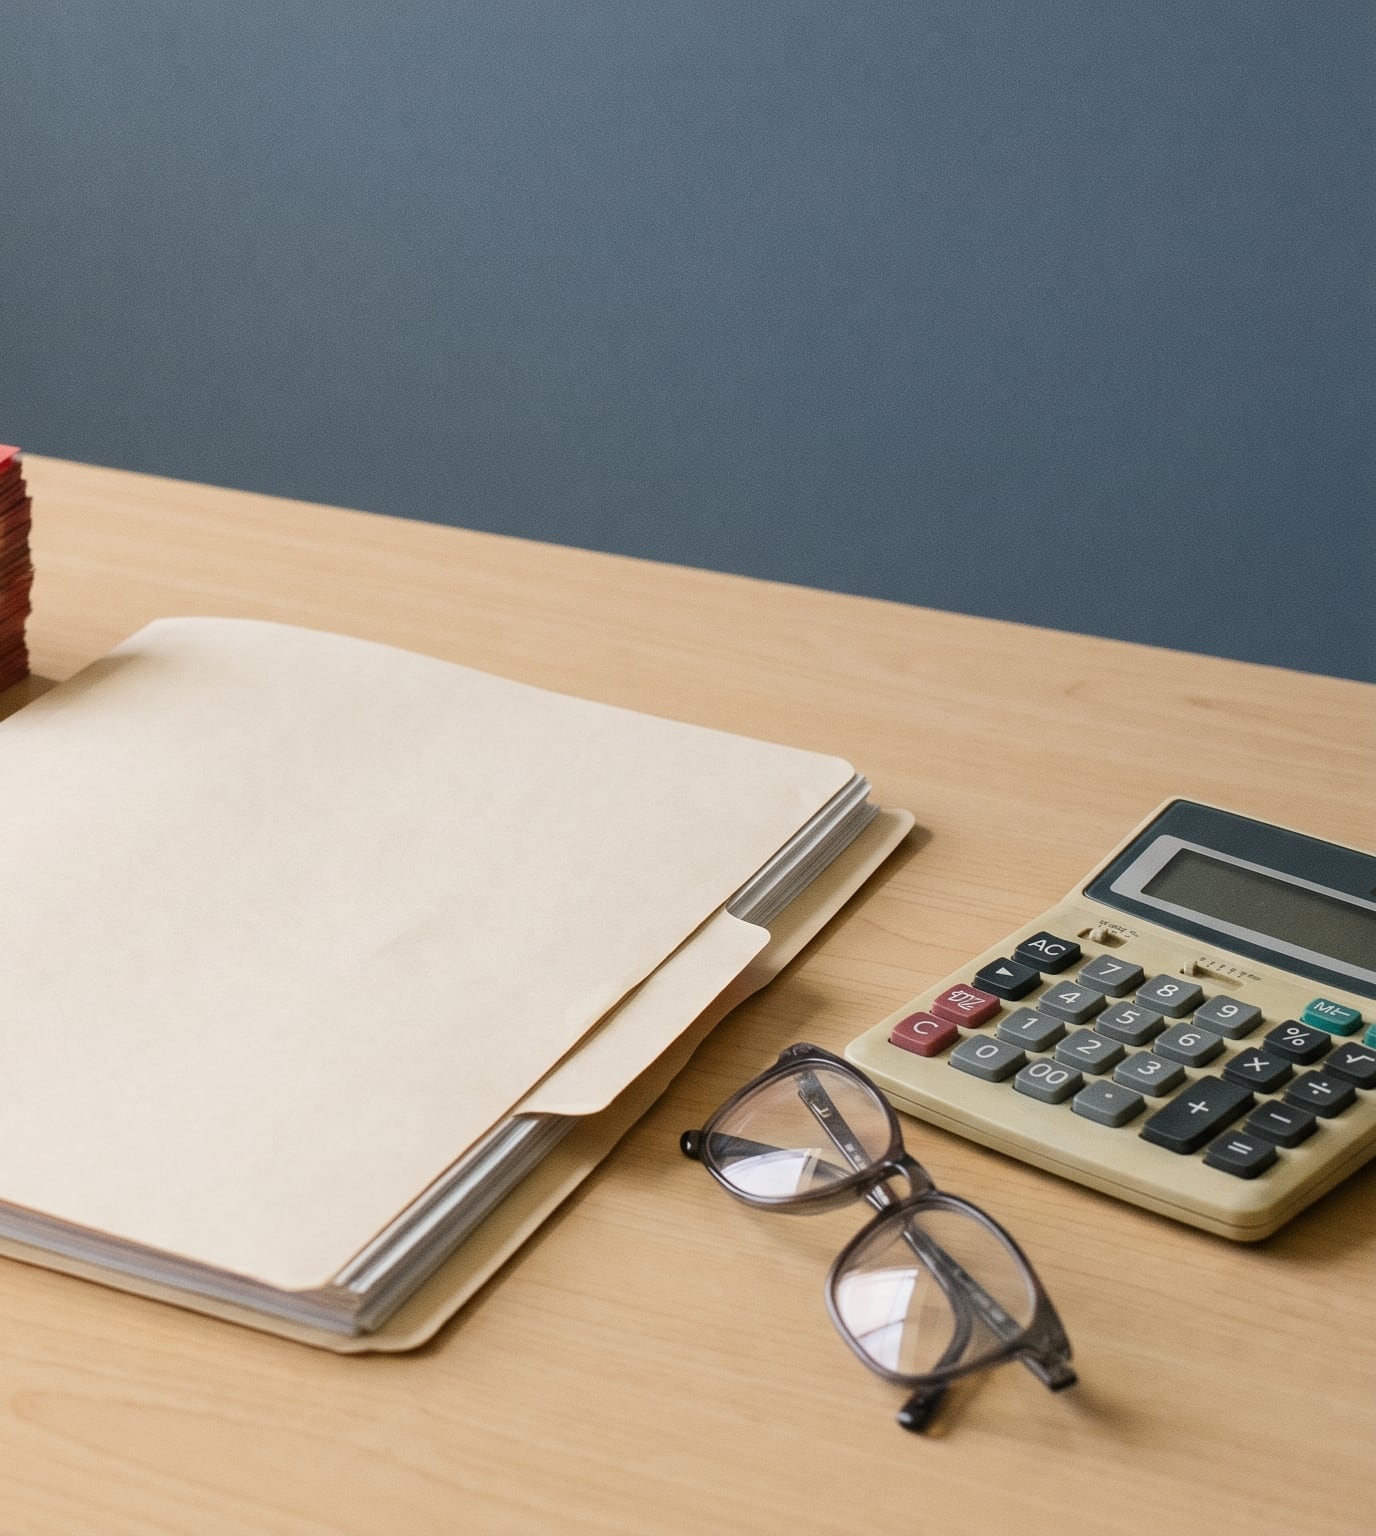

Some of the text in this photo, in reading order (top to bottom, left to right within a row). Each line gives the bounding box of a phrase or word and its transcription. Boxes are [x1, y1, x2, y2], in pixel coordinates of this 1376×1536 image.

[1027, 938, 1067, 956] AC
[1098, 962, 1122, 975] 7
[1156, 984, 1179, 997] 8
[1058, 992, 1081, 1004] 4
[1115, 1010, 1141, 1024] 5
[1216, 1004, 1239, 1018] 9
[913, 1020, 939, 1035] C
[1021, 1017, 1039, 1030] 1
[1178, 1033, 1201, 1047] 6
[1282, 1027, 1311, 1046] %
[975, 1044, 999, 1059] 0
[1076, 1039, 1102, 1055] 2
[1028, 1062, 1069, 1085] 00
[1137, 1060, 1162, 1075] 3
